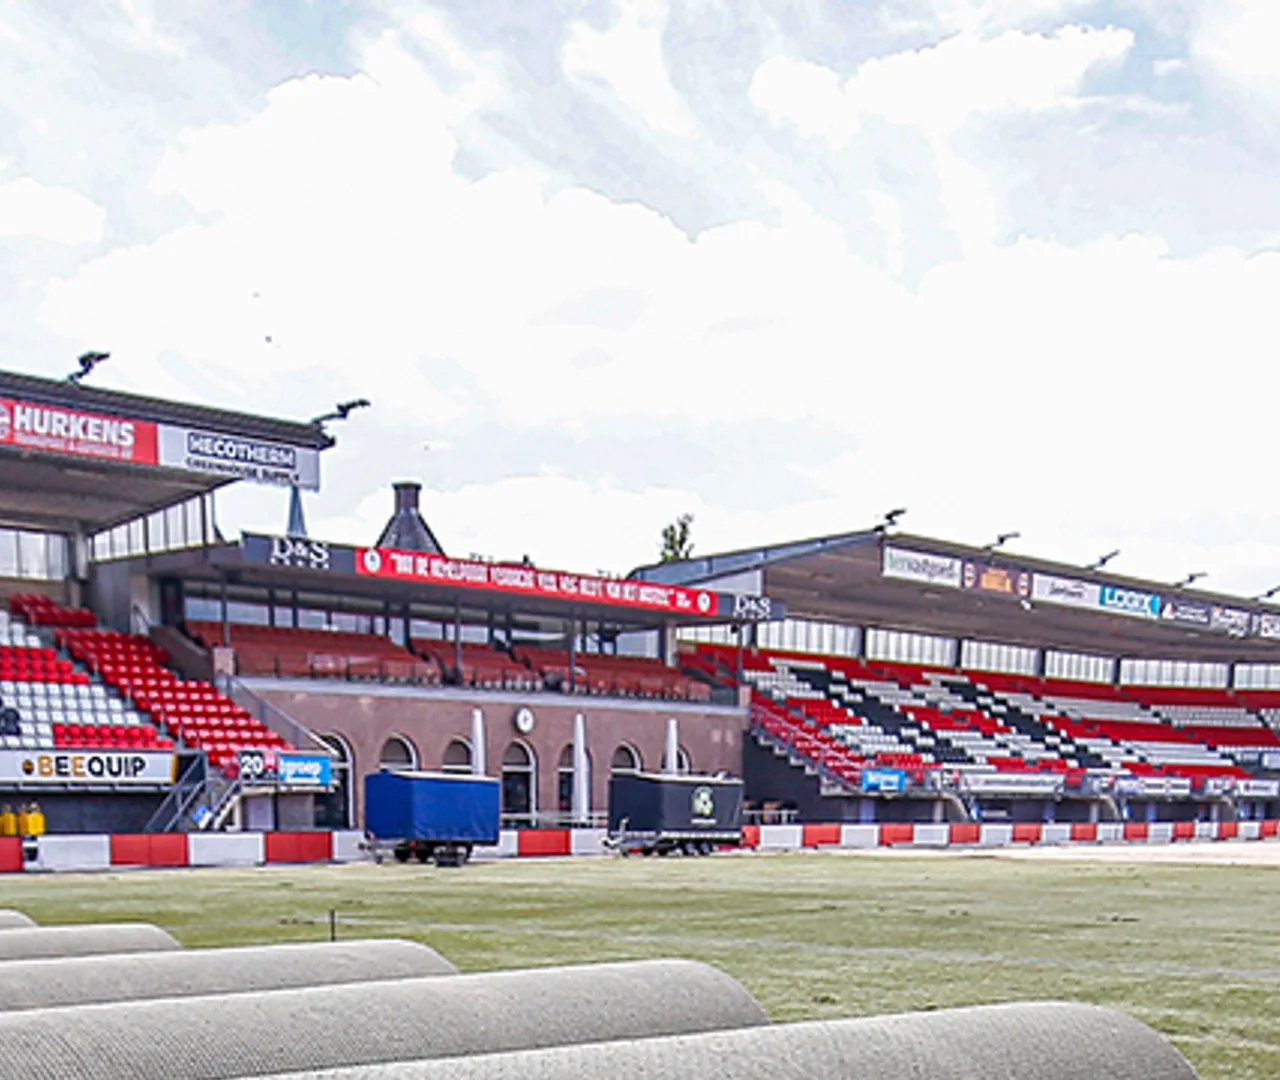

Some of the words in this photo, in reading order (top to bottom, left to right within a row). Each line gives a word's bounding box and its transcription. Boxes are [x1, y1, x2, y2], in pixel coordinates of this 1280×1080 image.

[13, 404, 135, 448] HURKENS
[271, 535, 329, 562] D&S
[38, 755, 147, 778] BEEQUIP
[240, 756, 264, 776] 20
